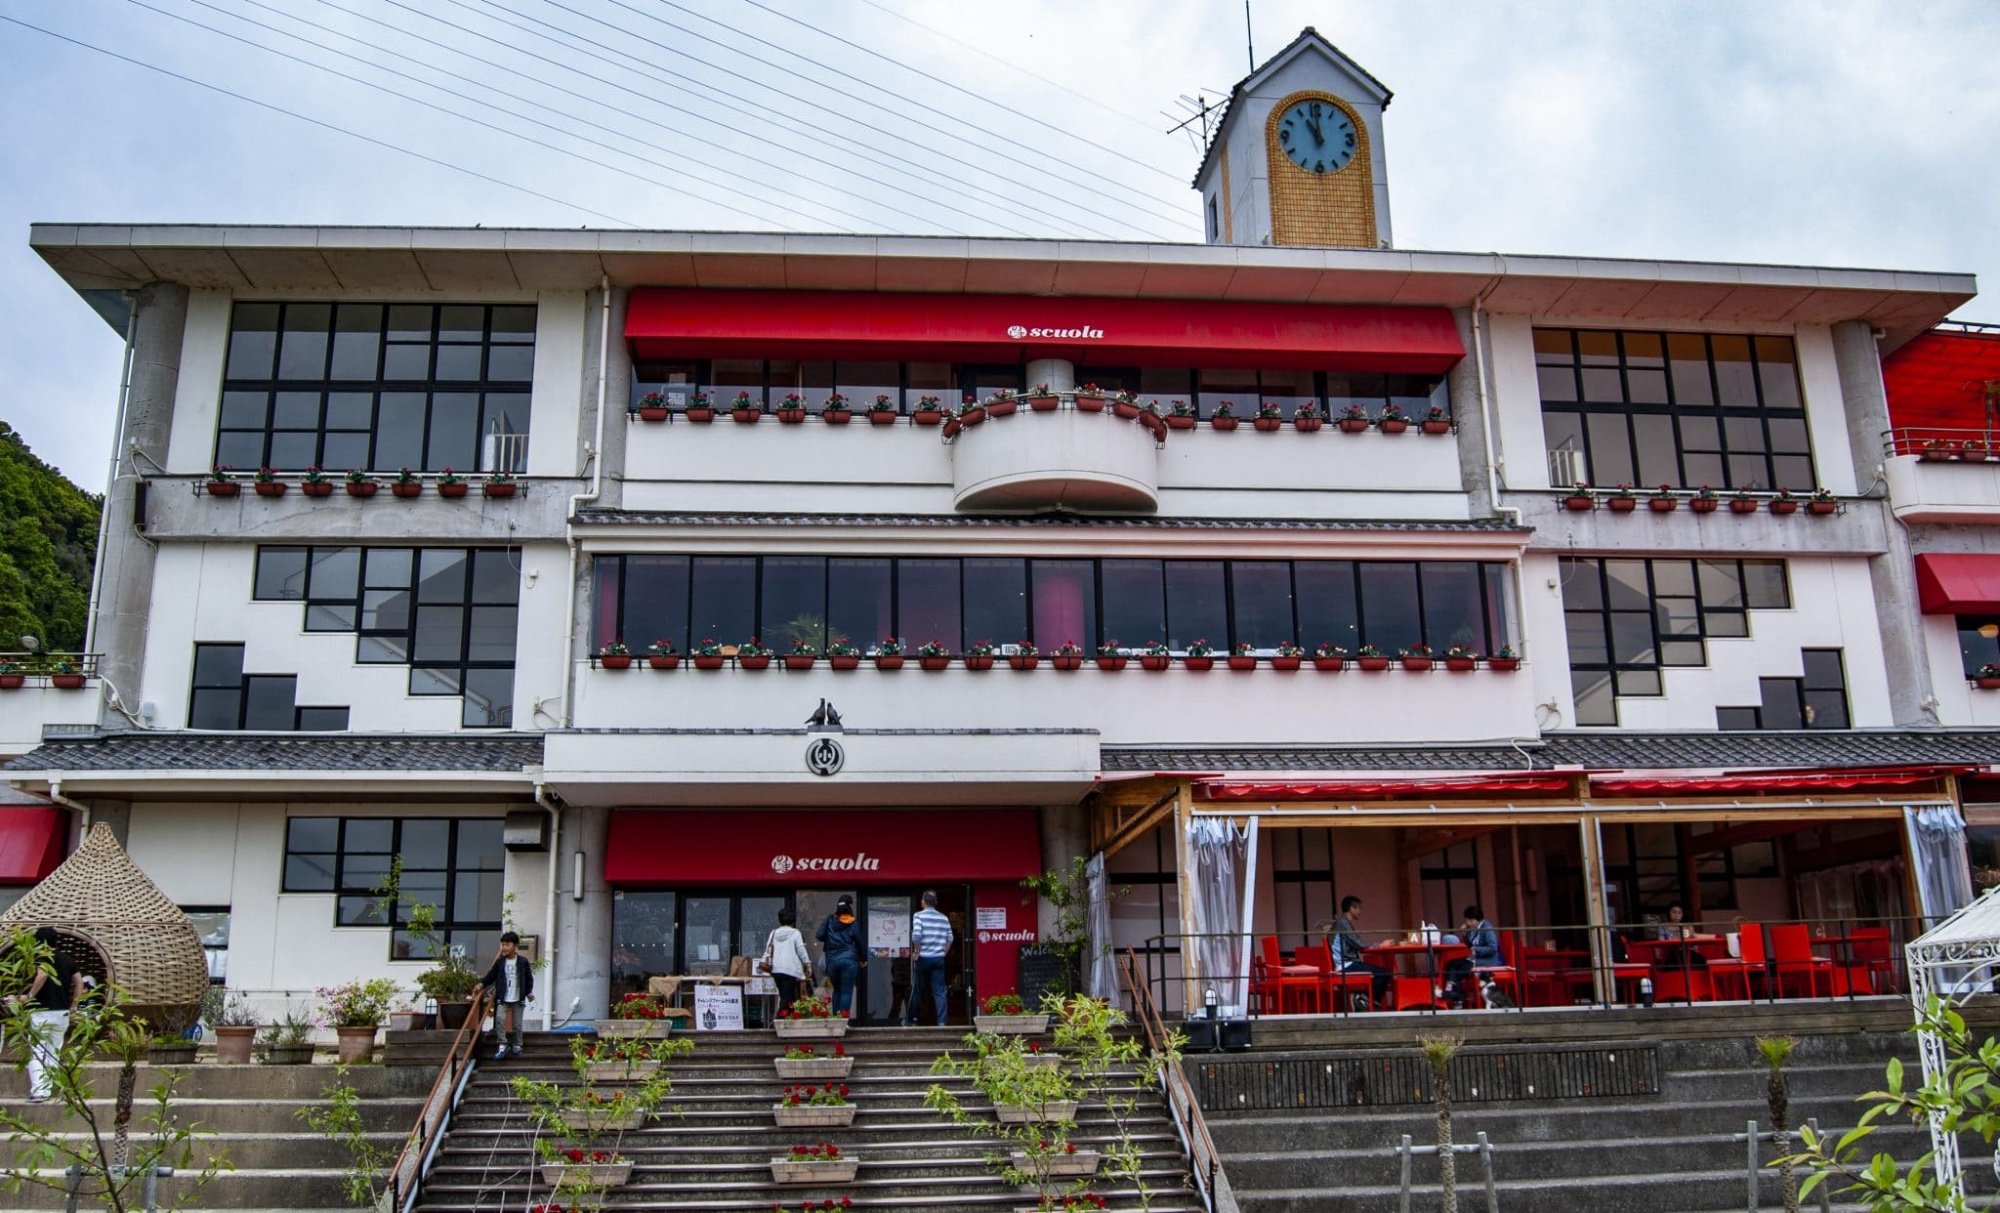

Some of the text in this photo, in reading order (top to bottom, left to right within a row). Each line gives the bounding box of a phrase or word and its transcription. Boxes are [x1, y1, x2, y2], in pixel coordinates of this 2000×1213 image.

[1029, 325, 1104, 339] scuola
[796, 852, 880, 871] scuola
[991, 929, 1035, 942] scuola
